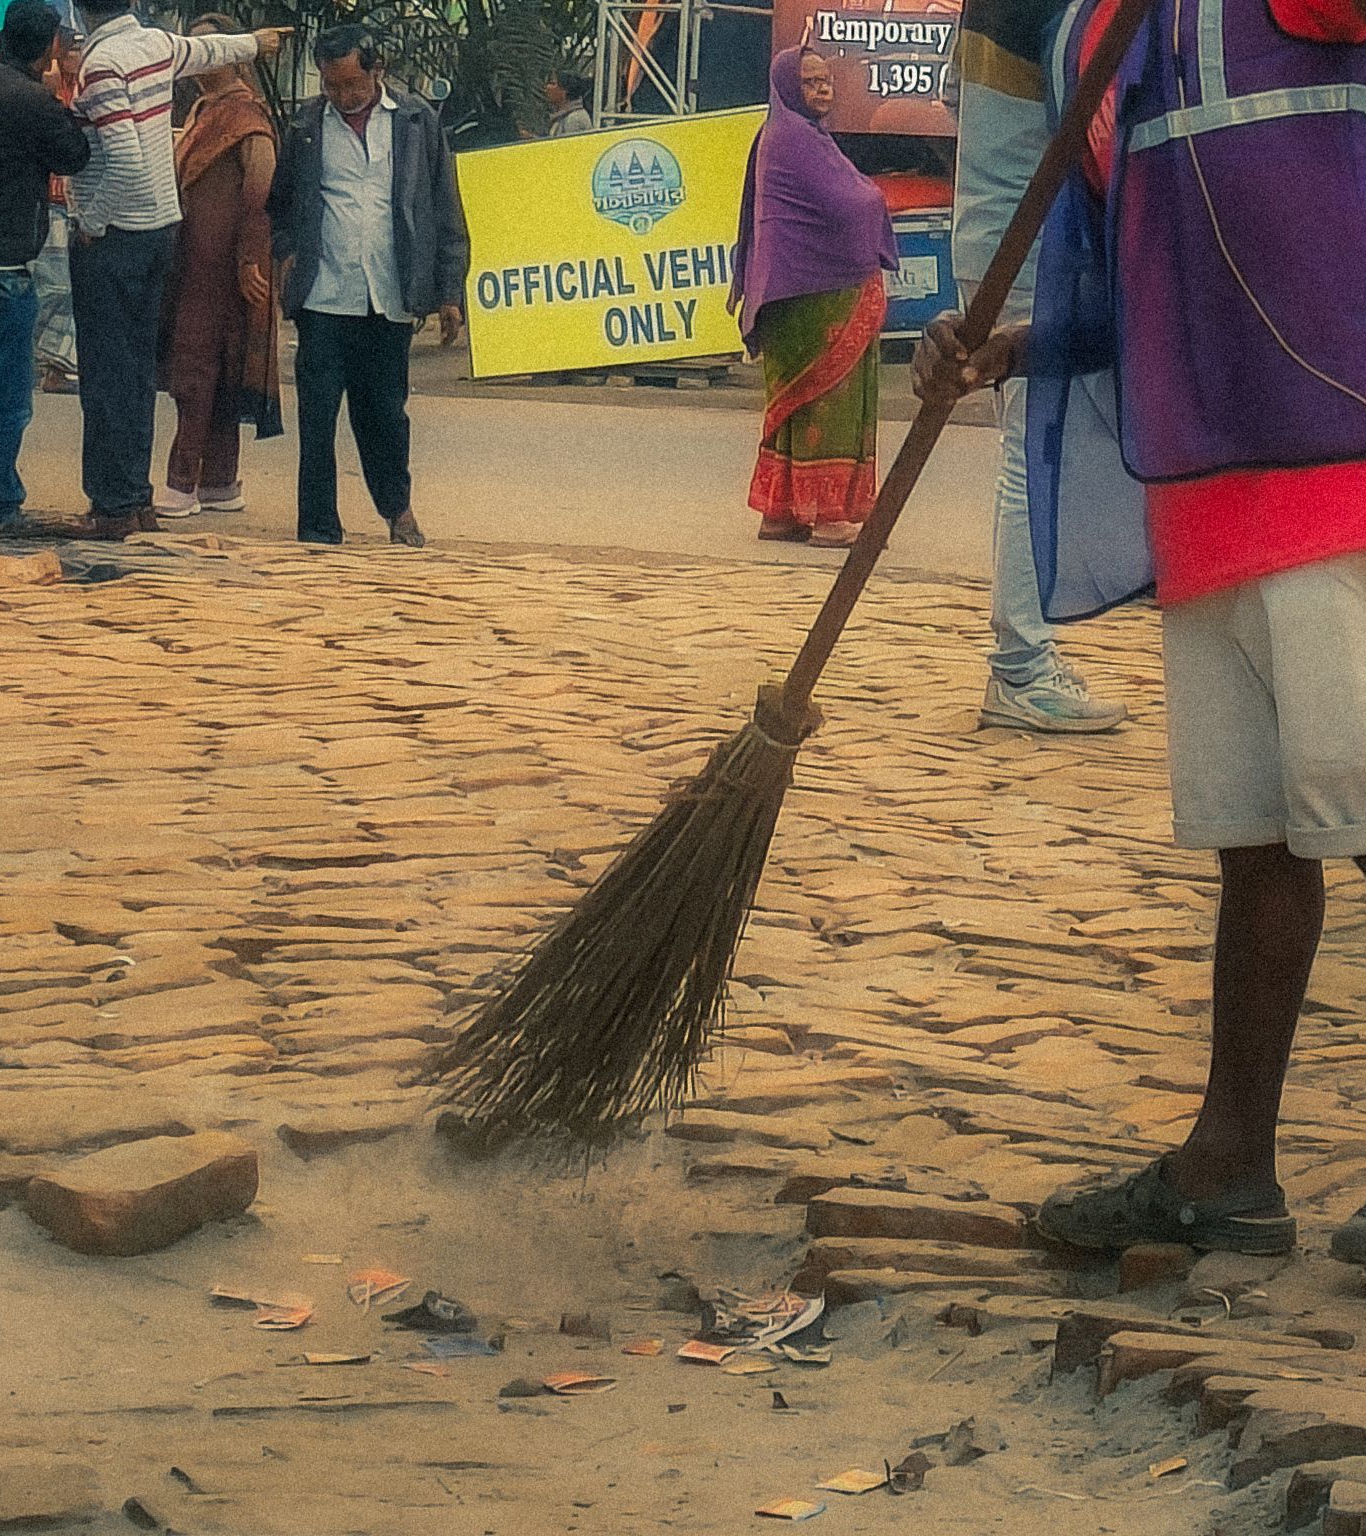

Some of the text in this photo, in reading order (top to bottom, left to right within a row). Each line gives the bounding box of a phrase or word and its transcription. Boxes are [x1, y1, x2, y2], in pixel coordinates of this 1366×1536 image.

[816, 10, 953, 54] Temporary
[868, 63, 933, 97] 1,395
[477, 256, 635, 310] OFFICIAL
[604, 298, 697, 346] ONLY
